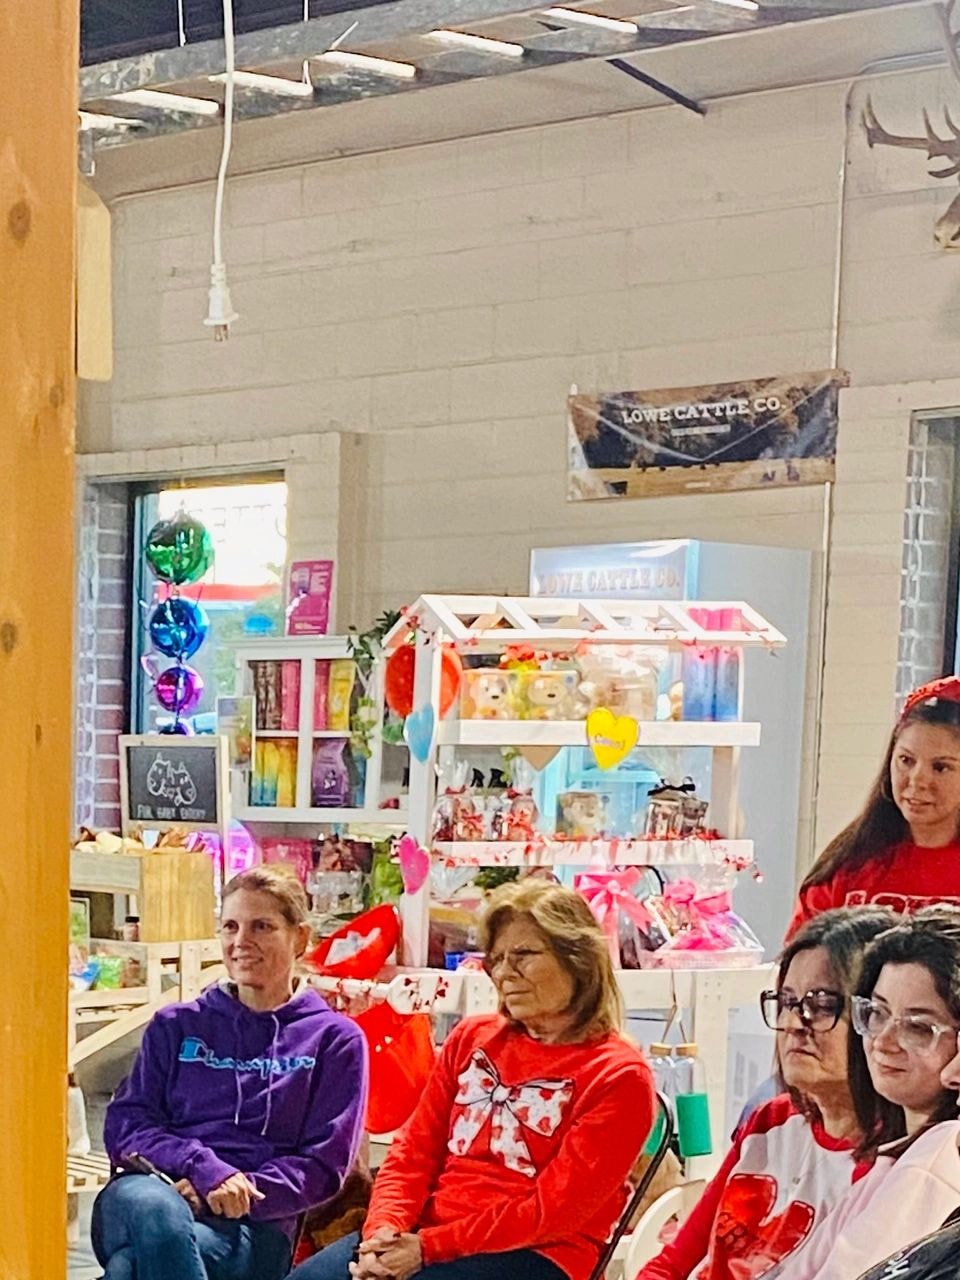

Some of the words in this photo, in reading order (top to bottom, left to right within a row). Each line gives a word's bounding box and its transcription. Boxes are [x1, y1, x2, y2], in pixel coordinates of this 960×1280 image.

[621, 408, 671, 424] LOWE
[674, 400, 749, 420] CATTLE
[753, 397, 787, 413] CO.
[539, 571, 584, 595] LOWE
[588, 567, 651, 593] CATTLE
[655, 567, 681, 589] CO.
